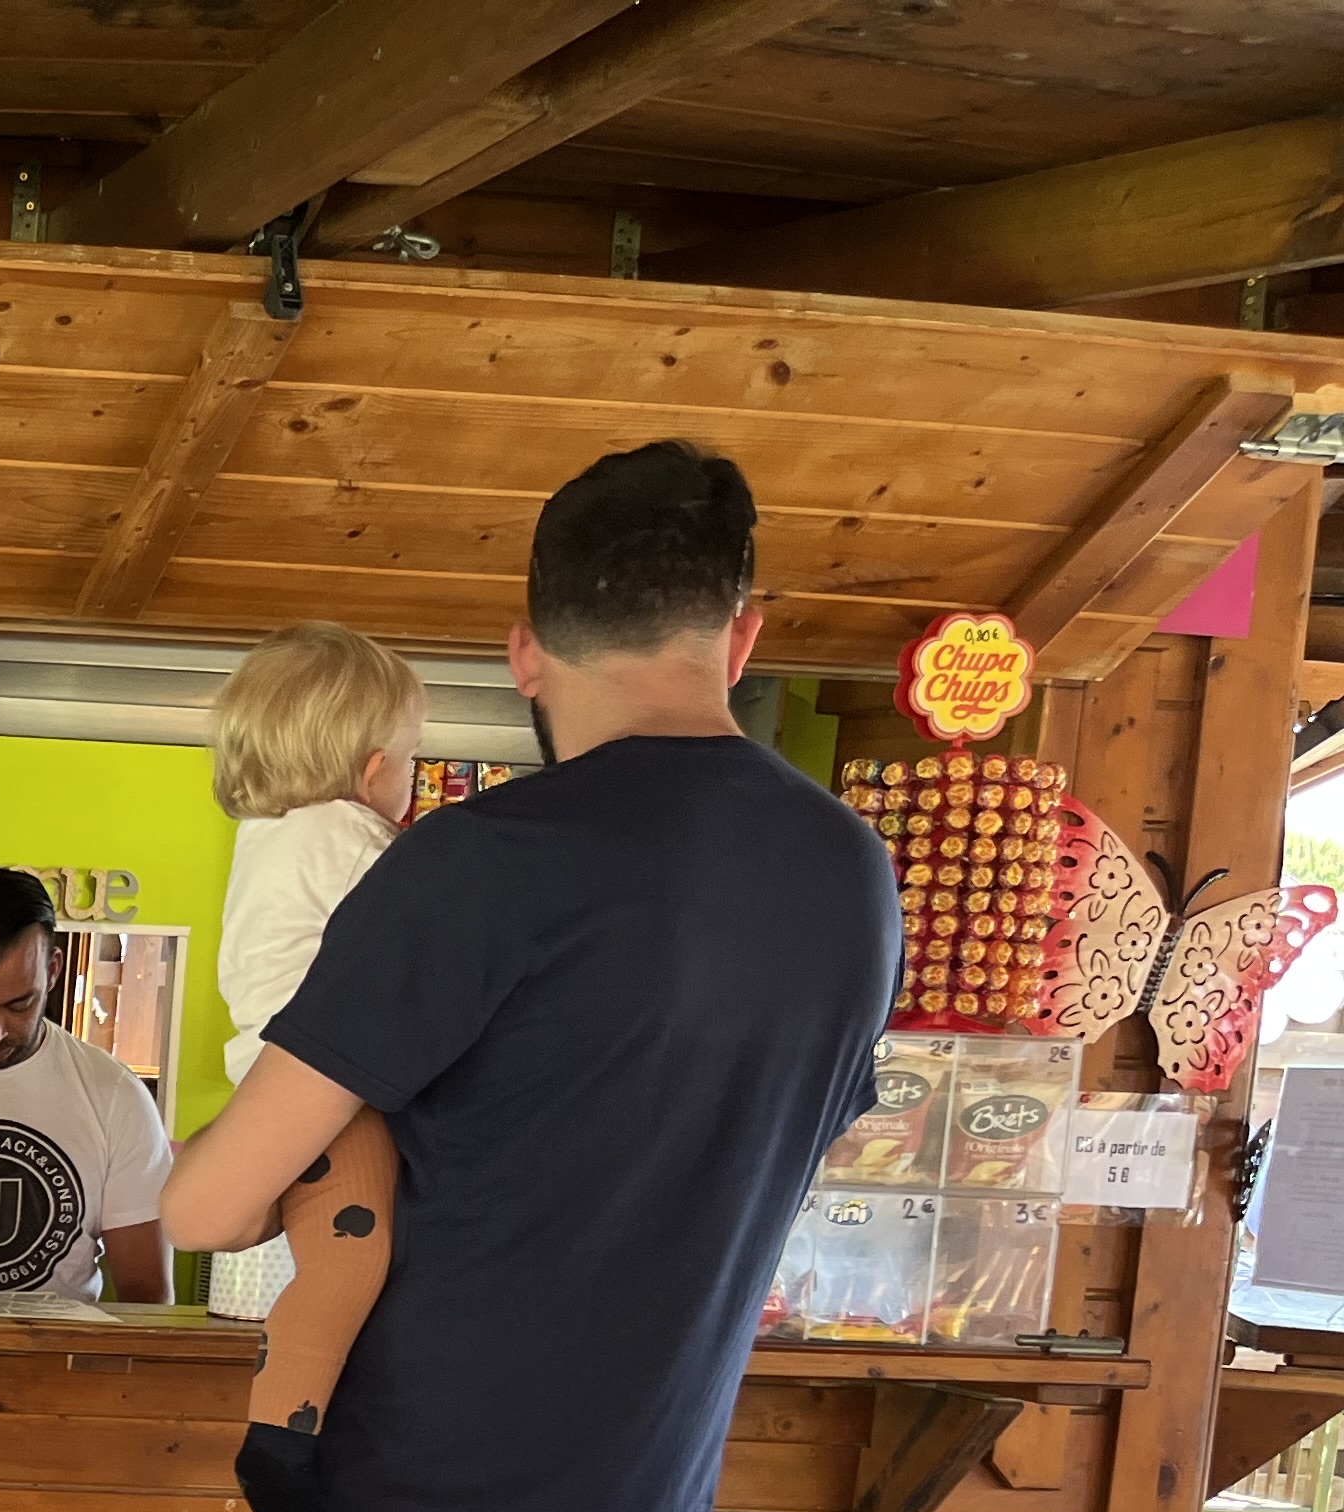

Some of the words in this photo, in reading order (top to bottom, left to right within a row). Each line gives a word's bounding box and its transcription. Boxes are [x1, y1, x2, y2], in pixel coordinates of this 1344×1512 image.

[933, 644, 1019, 679] Chupa
[925, 673, 1012, 720] Chups
[1098, 1139, 1106, 1154] à
[1109, 1140, 1148, 1157] partir
[1151, 1142, 1166, 1156] de
[1106, 1166, 1116, 1182] 5
